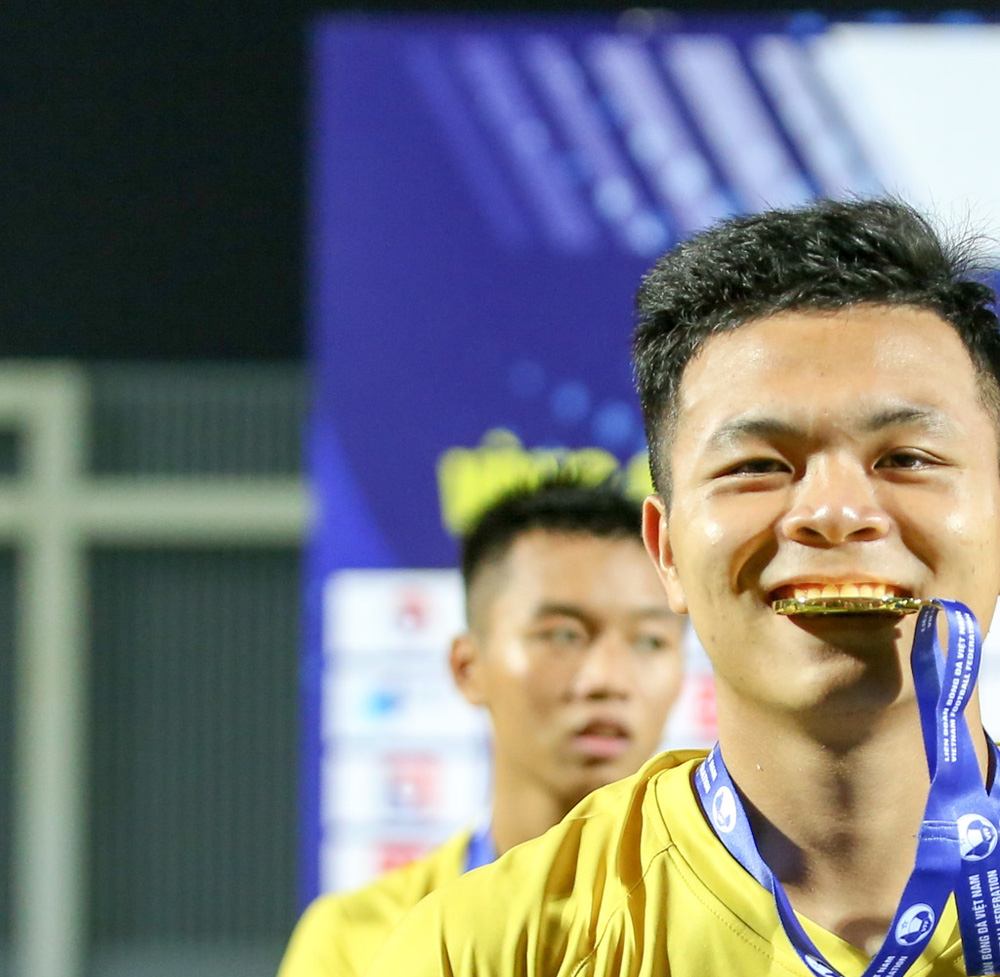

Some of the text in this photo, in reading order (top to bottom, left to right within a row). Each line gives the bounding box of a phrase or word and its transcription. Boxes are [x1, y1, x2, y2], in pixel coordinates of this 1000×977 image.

[950, 673, 971, 717] FOOTBALL
[964, 612, 975, 671] FEDERATION
[968, 874, 983, 898] NAM
